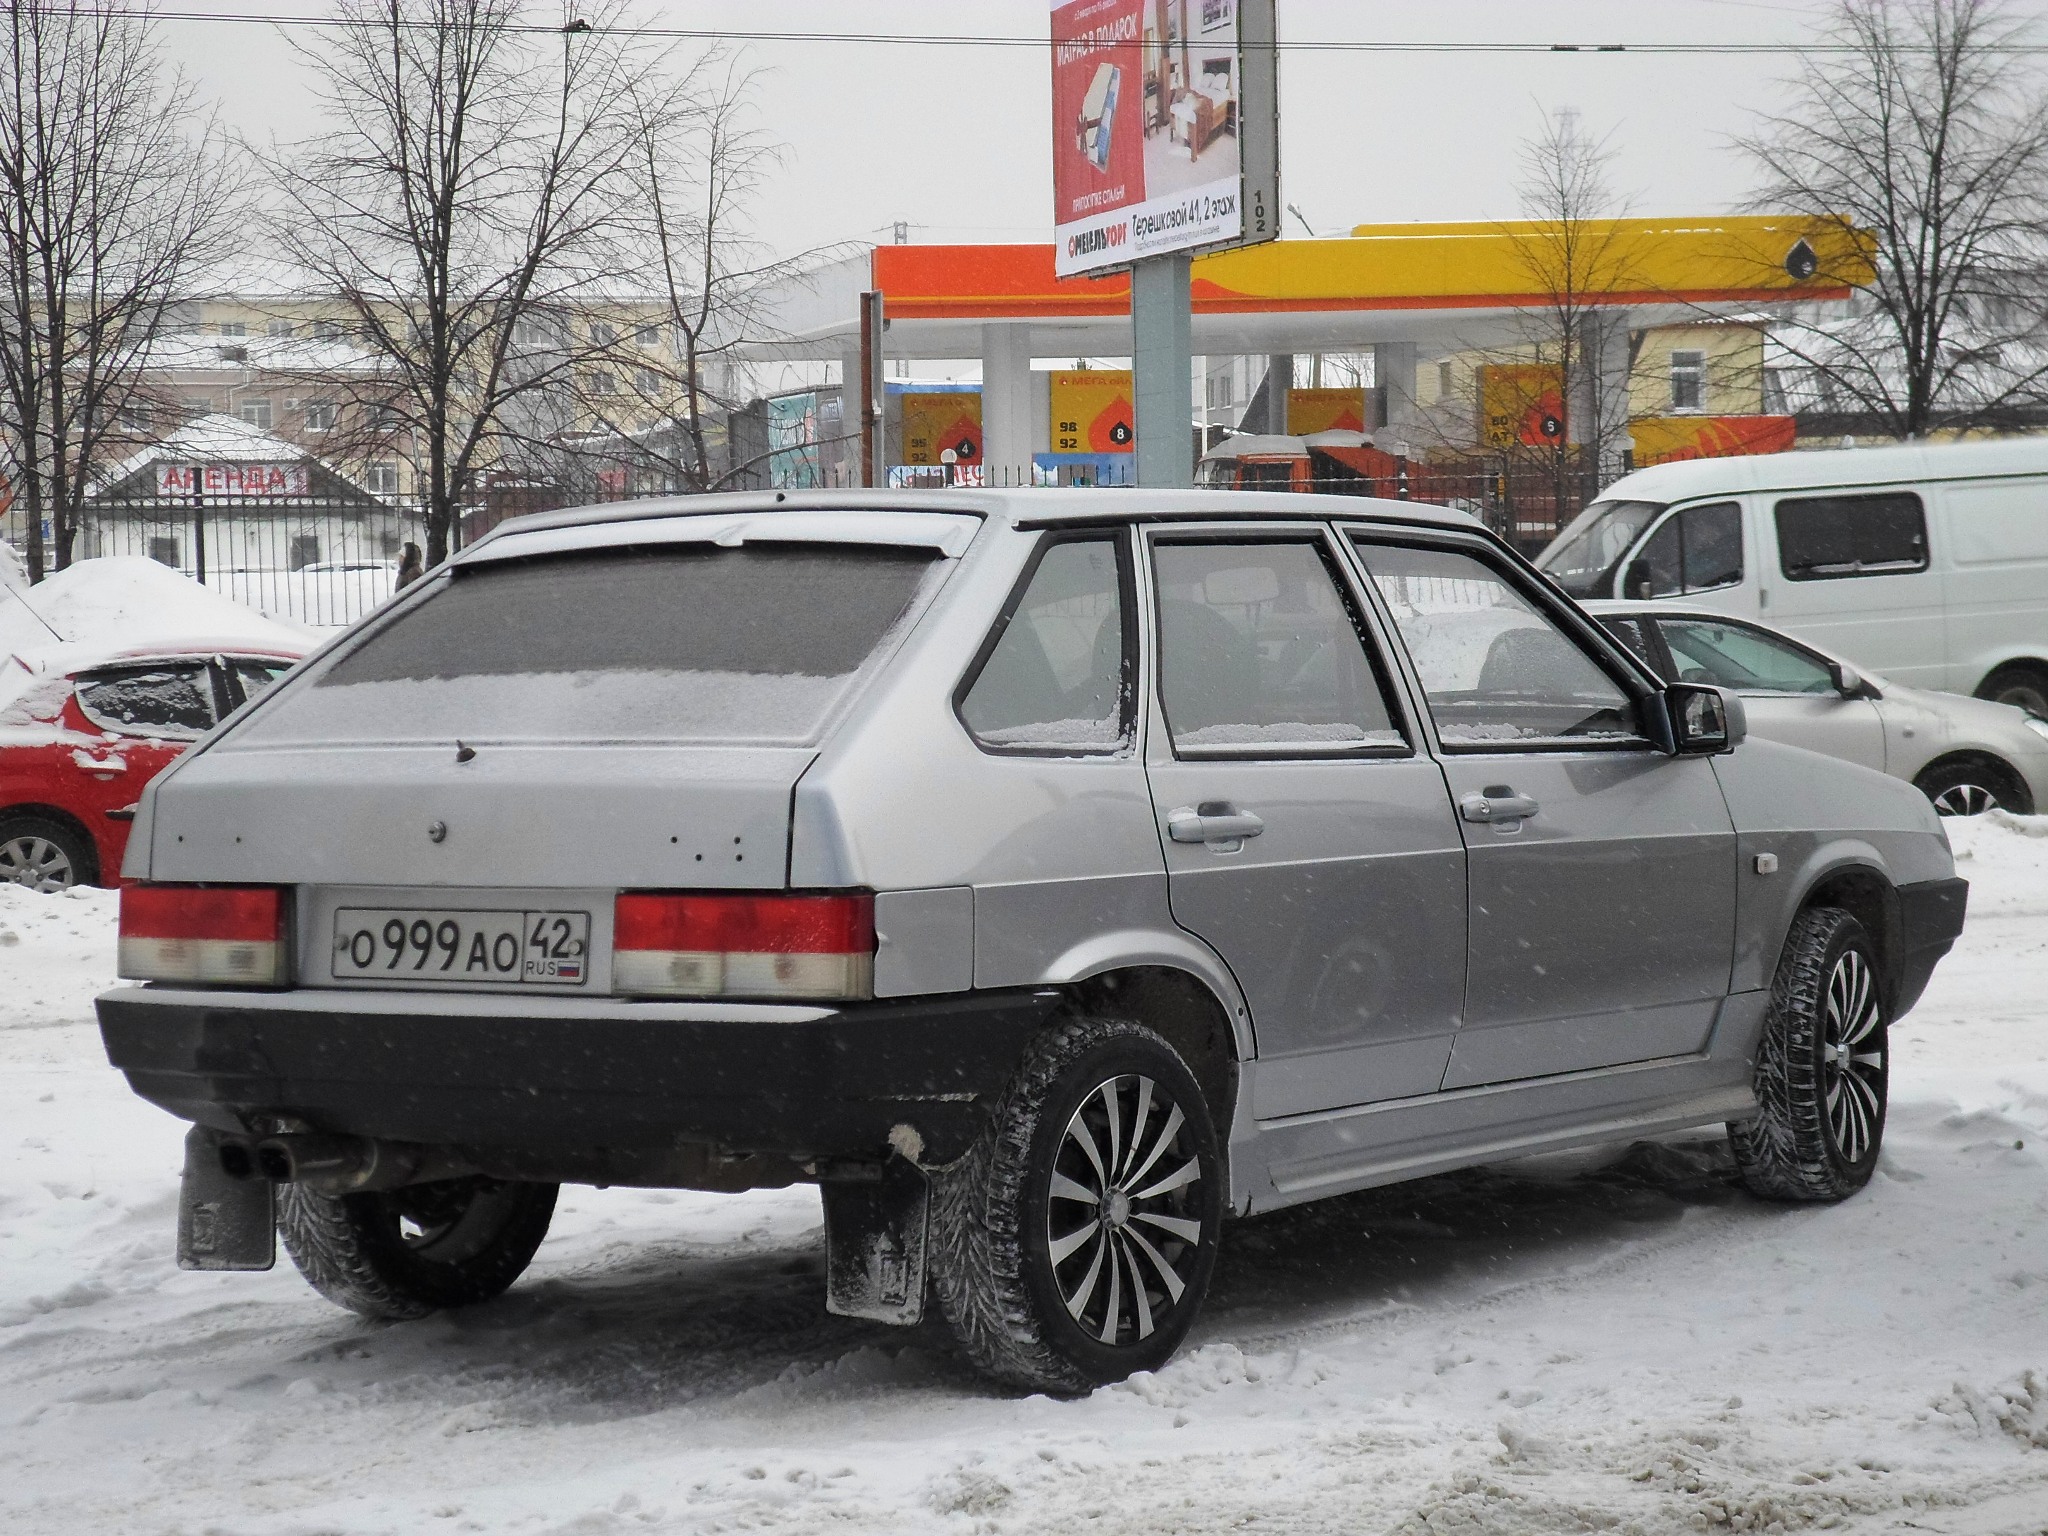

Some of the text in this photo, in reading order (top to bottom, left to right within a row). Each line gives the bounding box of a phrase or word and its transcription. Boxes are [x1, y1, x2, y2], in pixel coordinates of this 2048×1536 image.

[1057, 12, 1138, 67] МАТРАС В ПОДАРОК
[1132, 201, 1187, 240] Терешковой
[1188, 199, 1202, 225] 41,
[1204, 196, 1210, 220] 2
[1211, 195, 1236, 217] этаж
[1059, 421, 1077, 432] 98
[1116, 428, 1124, 439] 8
[961, 444, 969, 454] 4
[1059, 438, 1077, 449] 92
[911, 452, 927, 462] 92
[529, 918, 571, 959] 42
[525, 961, 556, 975] RUS
